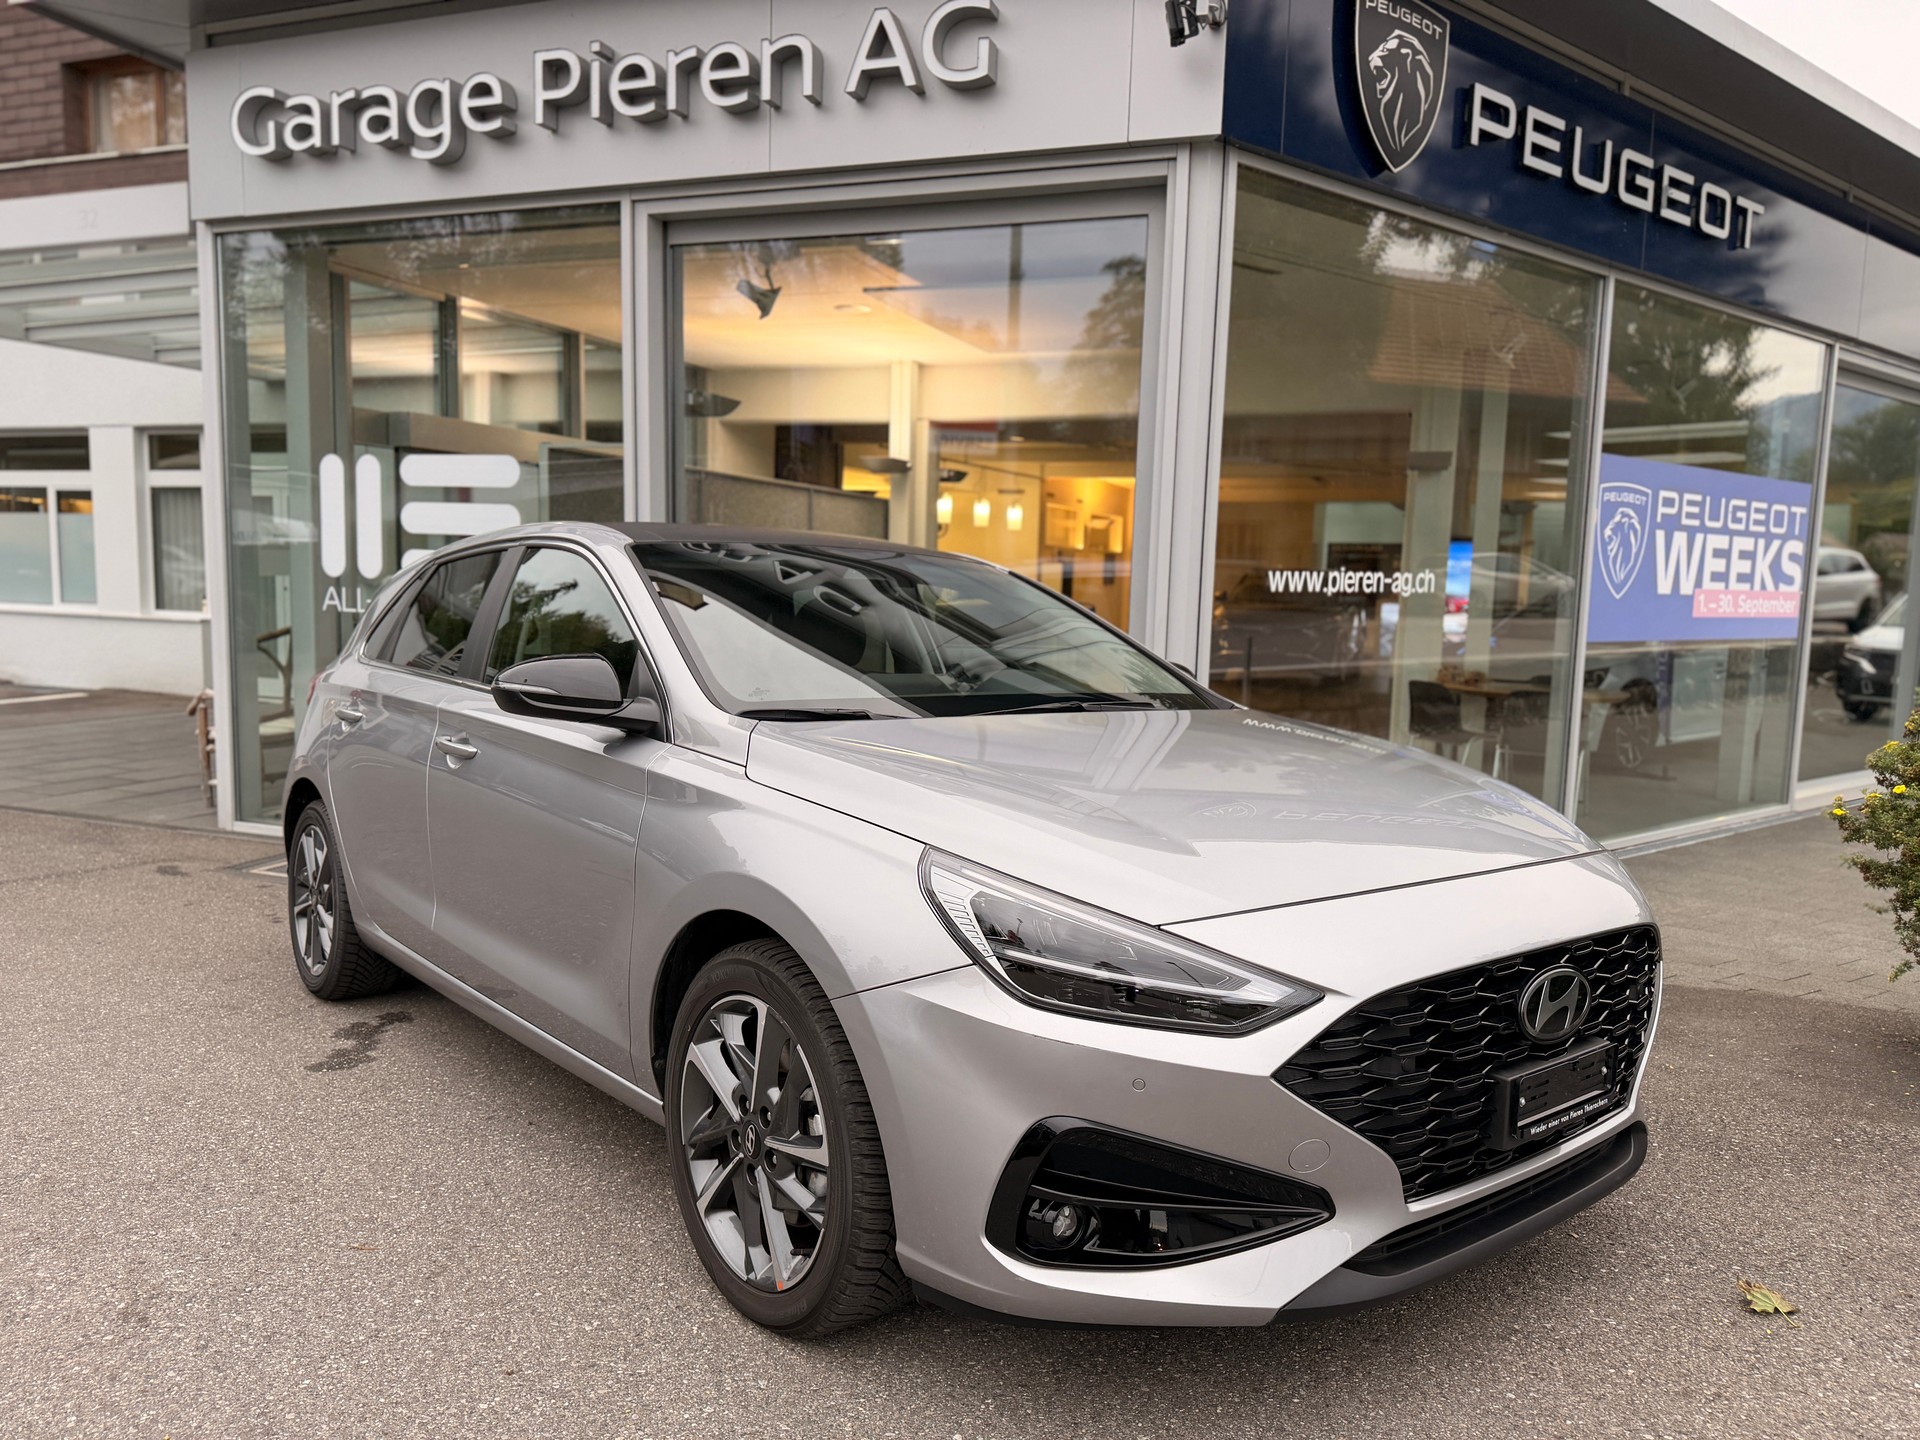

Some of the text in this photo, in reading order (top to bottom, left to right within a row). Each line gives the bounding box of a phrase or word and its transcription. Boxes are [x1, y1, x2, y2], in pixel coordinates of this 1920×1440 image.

[1365, 0, 1444, 40] PEUGEOT
[231, 0, 999, 163] Garage Pieren AG
[1467, 82, 1766, 250] PEUGEOT
[1603, 491, 1648, 506] PEUGEOT
[1656, 490, 1807, 535] PEUGEOT
[1268, 566, 1436, 597] www.pieren-ag.ch
[1655, 529, 1804, 595] WEEKS
[1737, 595, 1797, 617] September
[1530, 1122, 1548, 1136] Wieder
[1548, 1118, 1560, 1129] einer
[1560, 1114, 1570, 1123] von
[1569, 1108, 1584, 1120] Pieren
